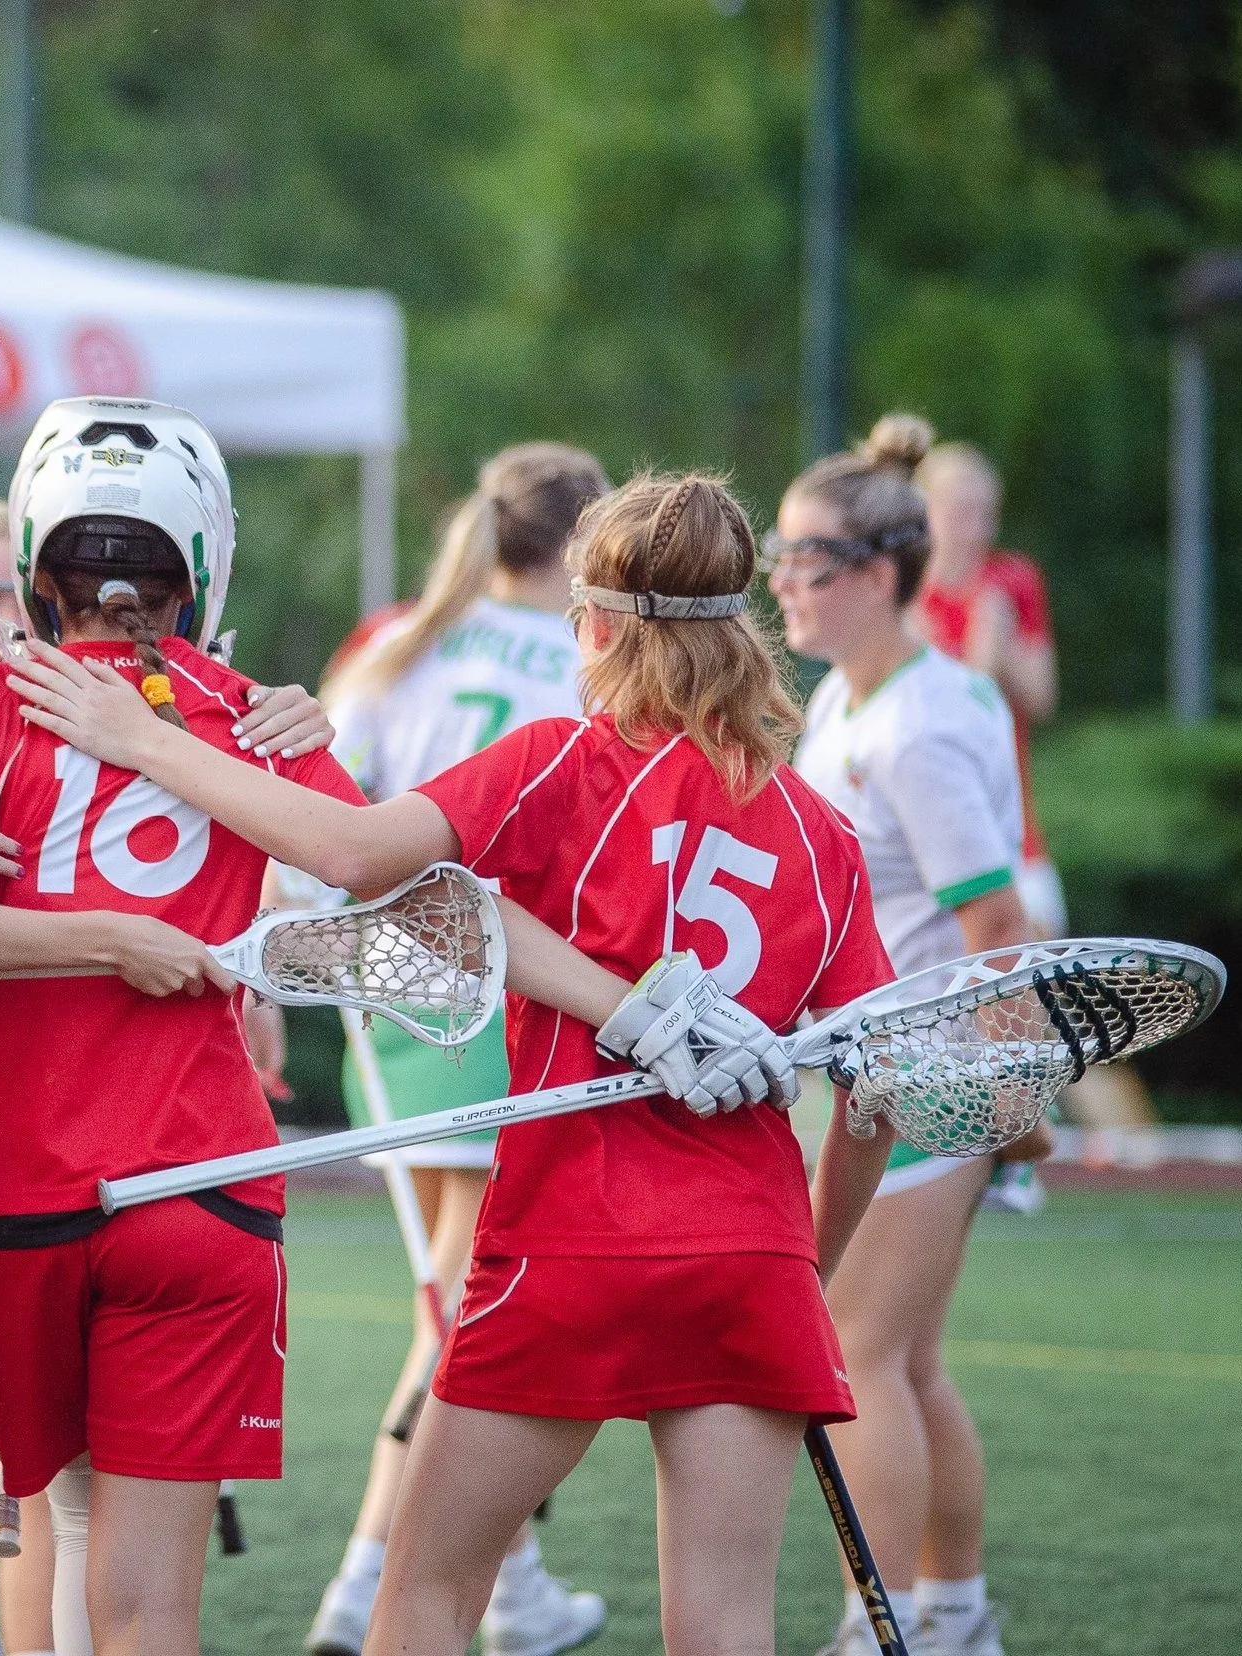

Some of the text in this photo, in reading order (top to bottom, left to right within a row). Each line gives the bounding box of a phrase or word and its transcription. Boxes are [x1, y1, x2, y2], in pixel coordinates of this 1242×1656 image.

[453, 690, 511, 754] 7
[37, 743, 213, 898] 16
[651, 820, 779, 1000] 15
[660, 1011, 682, 1035] 100%
[452, 1104, 516, 1123] SURGEON
[249, 1416, 282, 1429] KUKR
